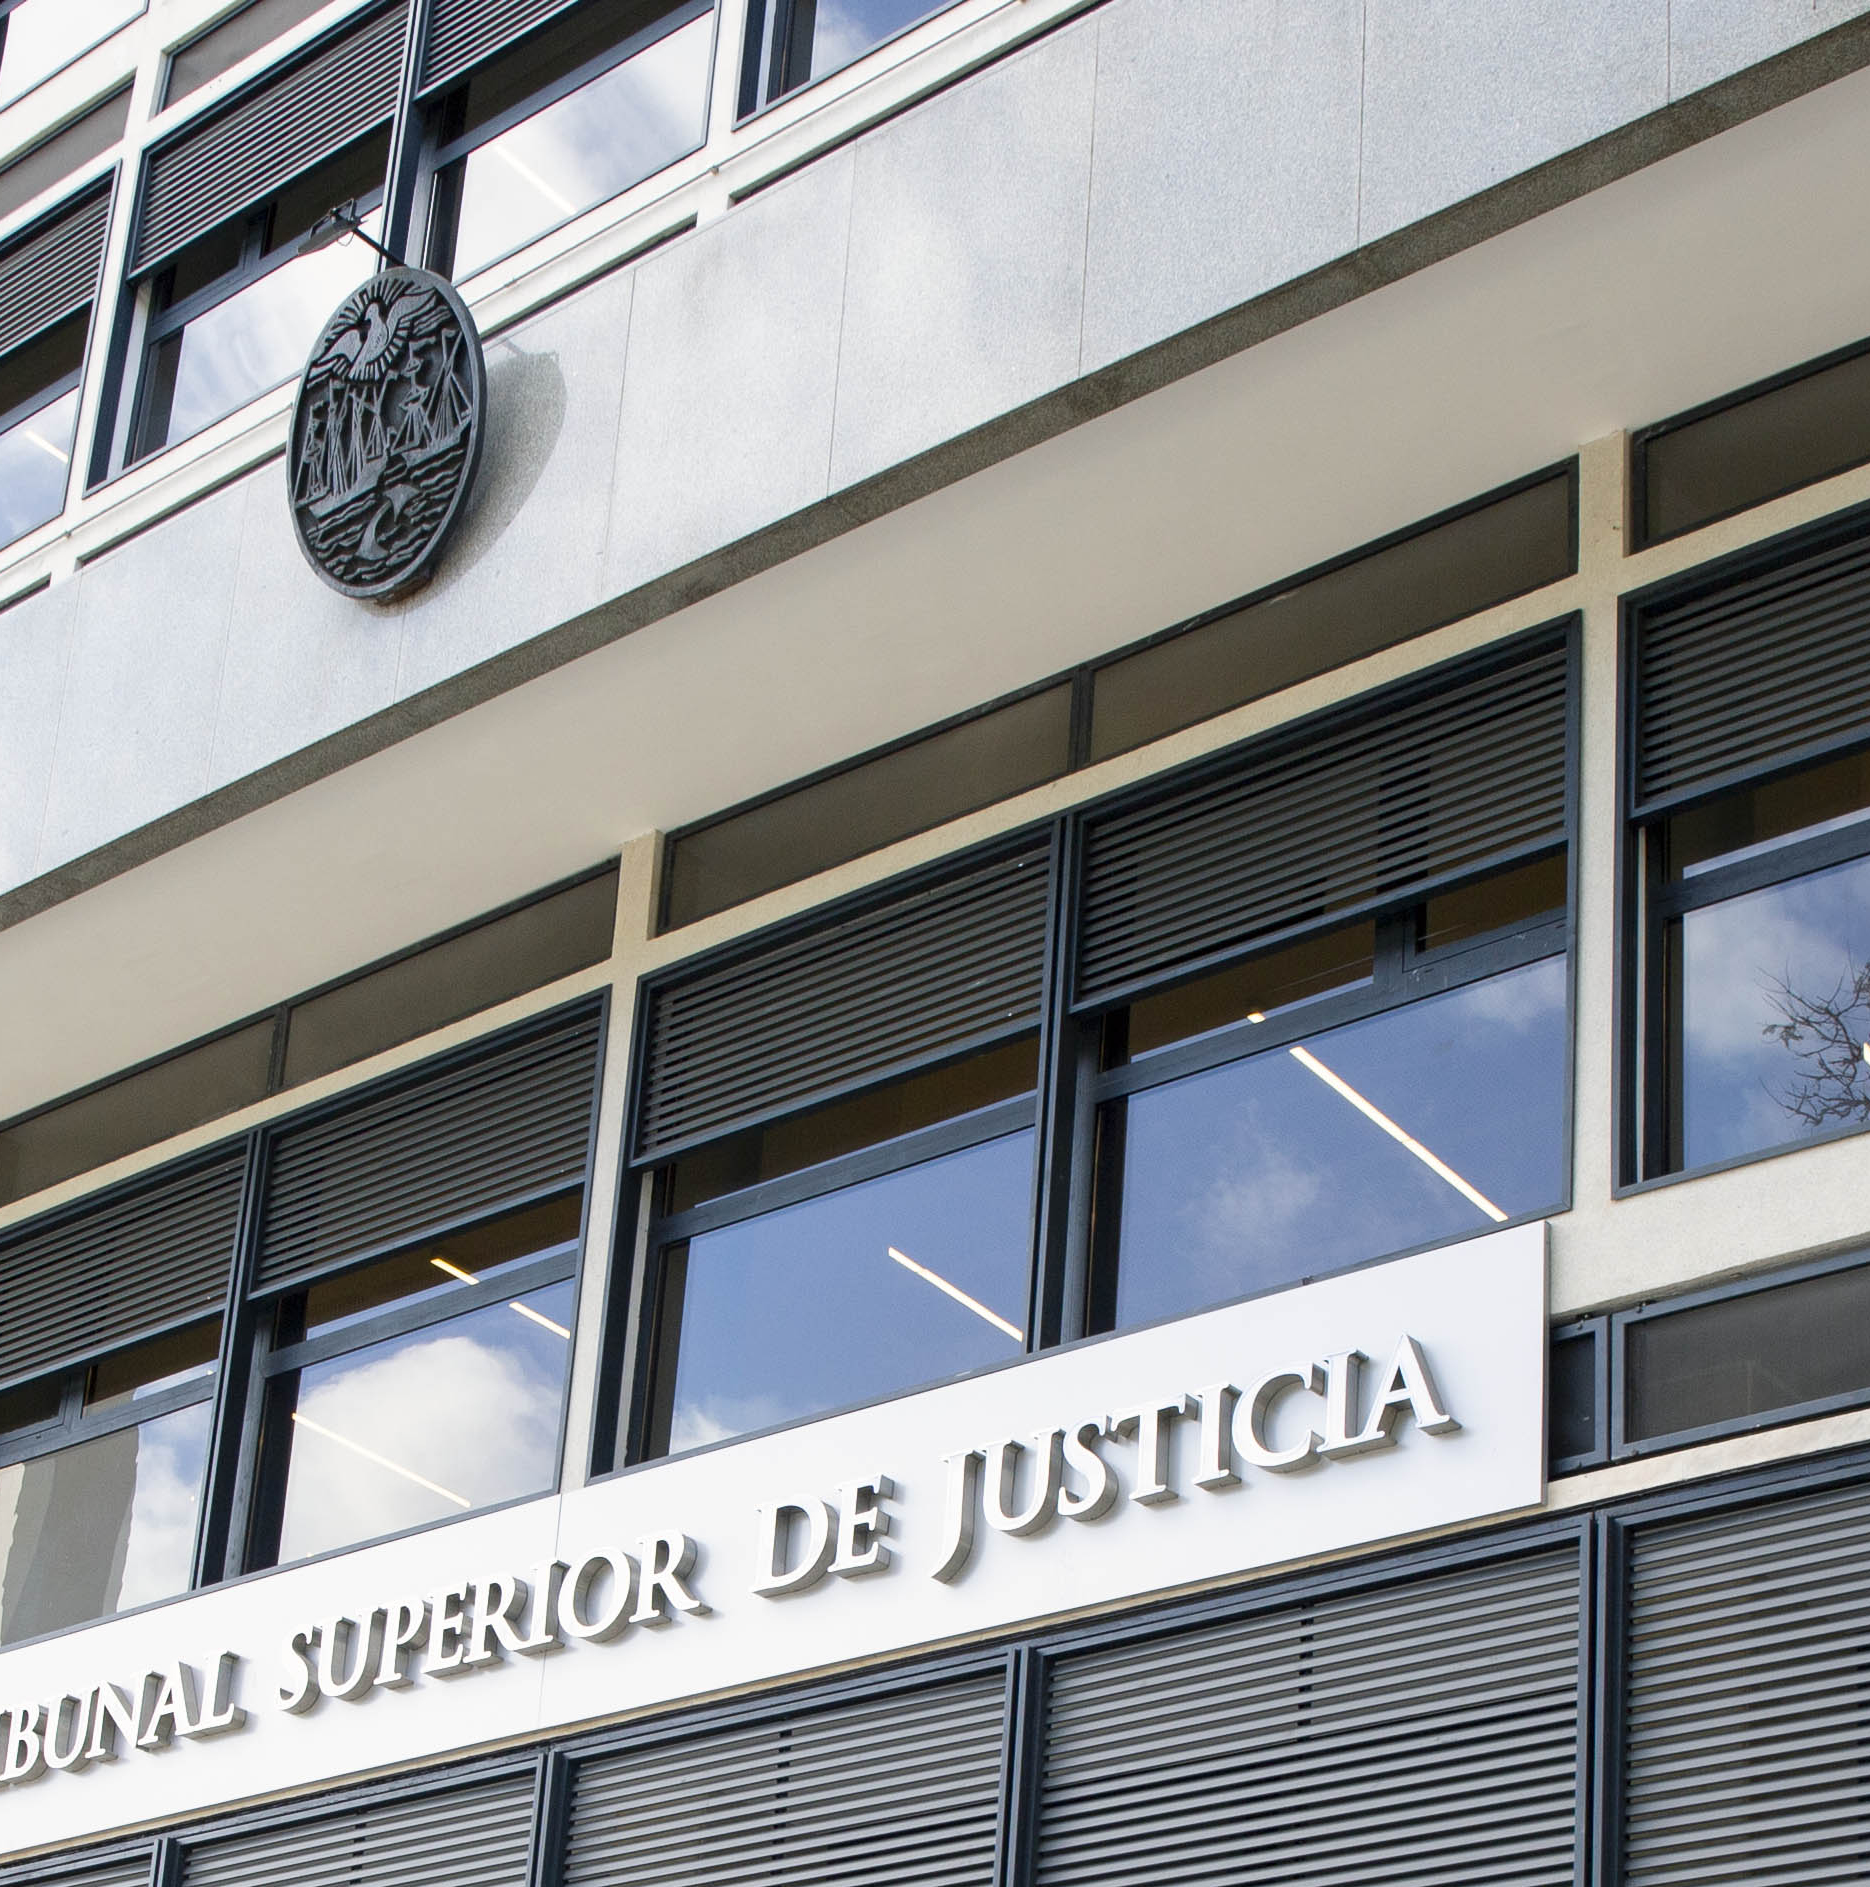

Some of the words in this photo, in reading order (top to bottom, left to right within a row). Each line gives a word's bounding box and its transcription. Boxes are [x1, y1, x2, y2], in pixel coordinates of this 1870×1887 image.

[278, 1529, 712, 1715] SUPERIOR
[750, 1474, 894, 1600] DE
[931, 1333, 1463, 1584] JUSTICIA
